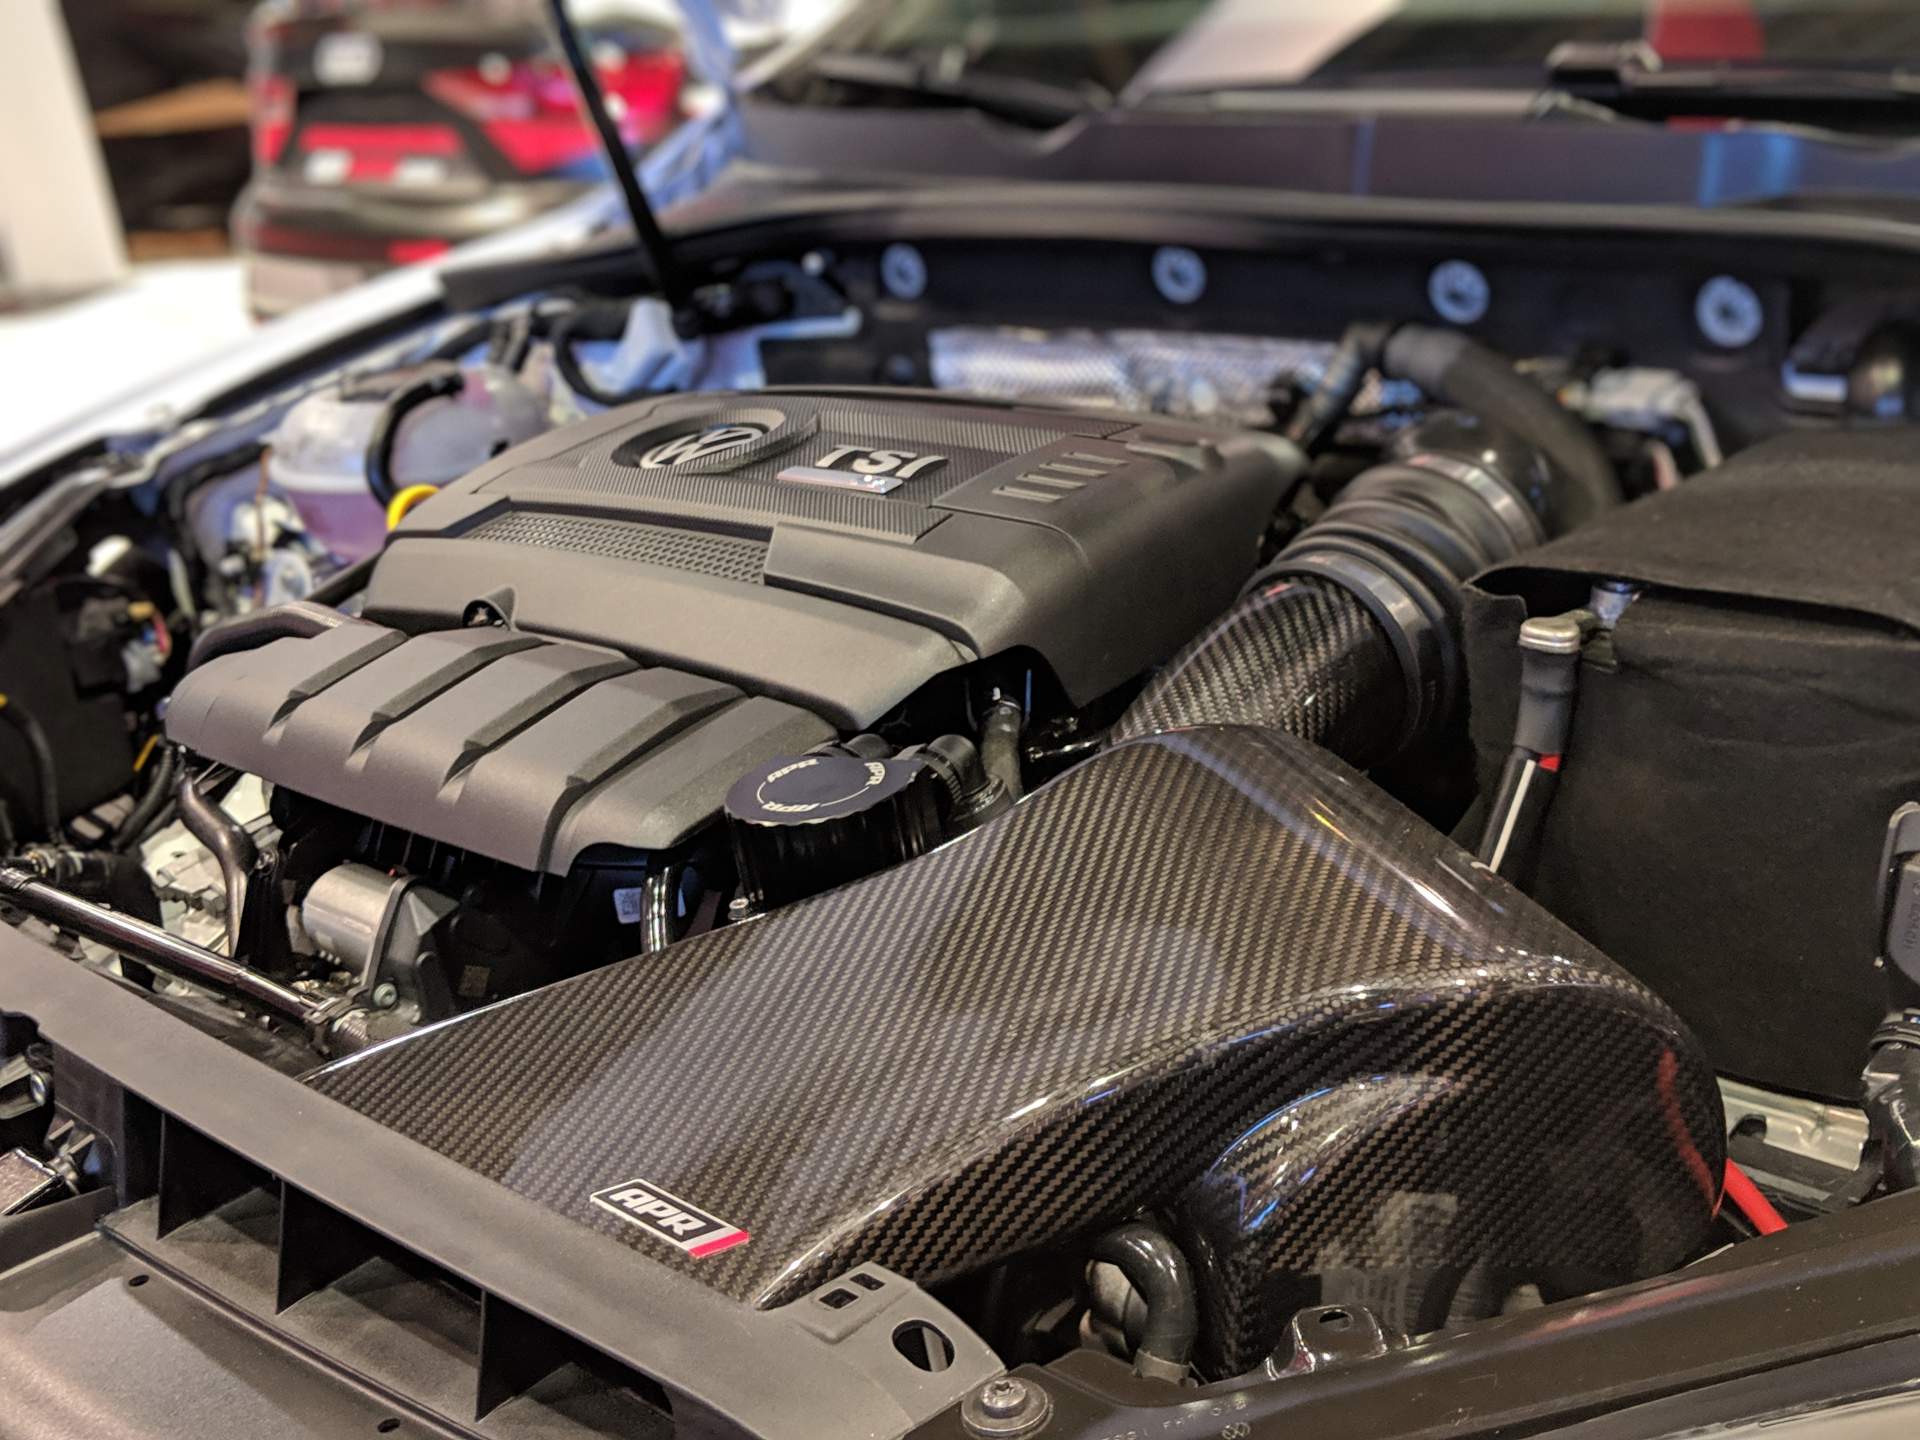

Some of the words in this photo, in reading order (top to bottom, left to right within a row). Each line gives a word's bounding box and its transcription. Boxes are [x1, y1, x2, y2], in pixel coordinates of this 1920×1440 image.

[815, 444, 947, 479] TSI
[864, 762, 886, 786] APR
[761, 801, 820, 812] APR
[608, 1188, 707, 1236] APR
